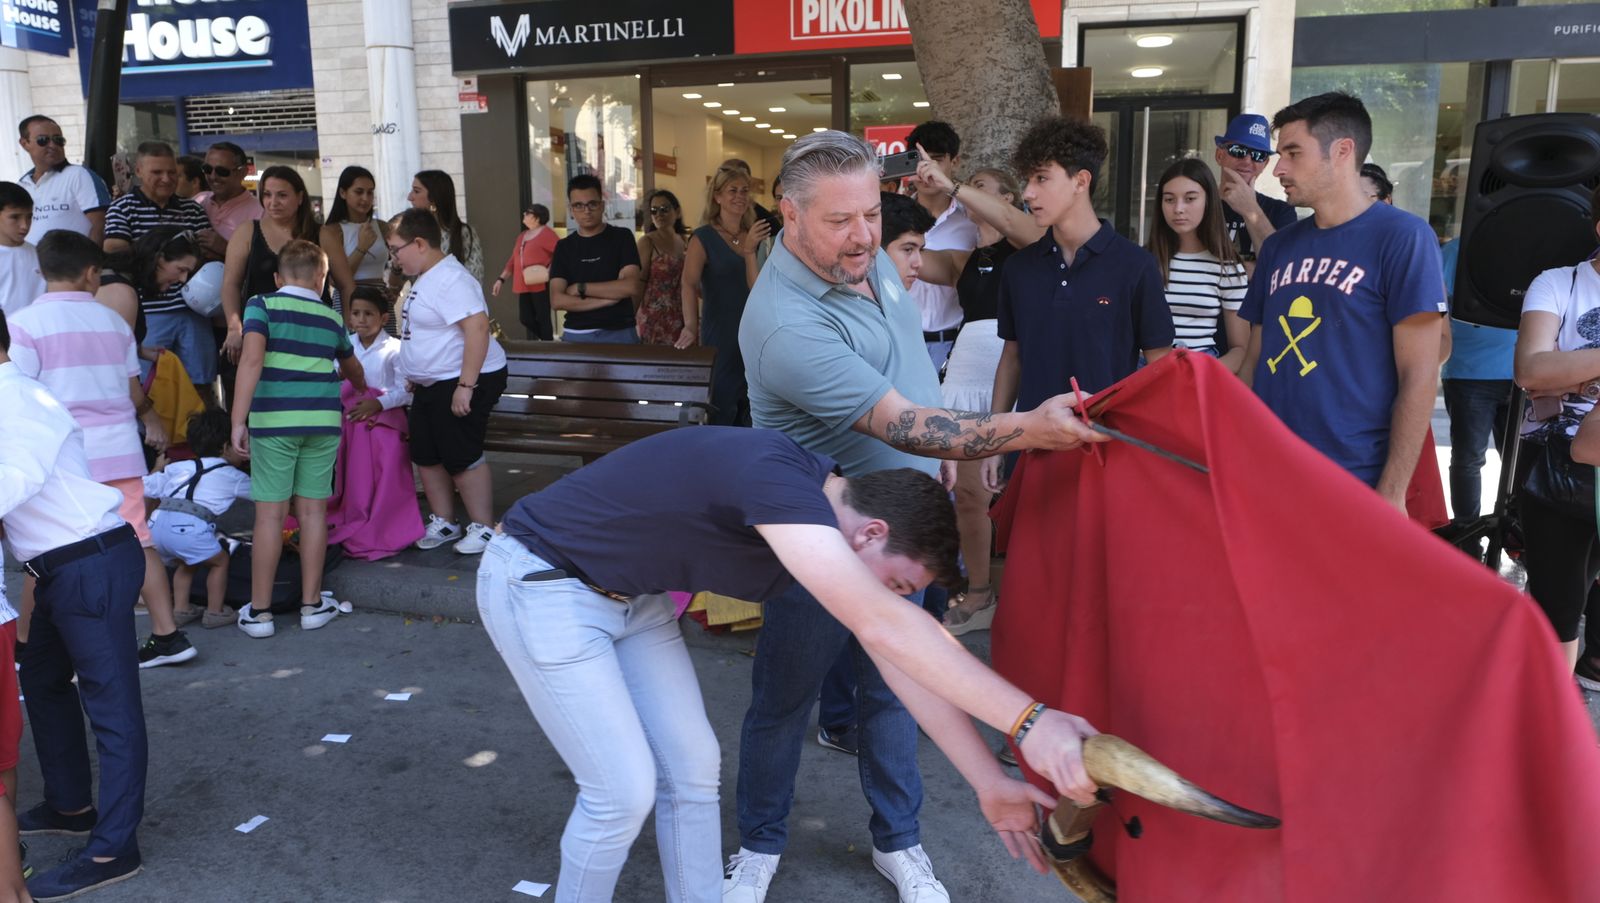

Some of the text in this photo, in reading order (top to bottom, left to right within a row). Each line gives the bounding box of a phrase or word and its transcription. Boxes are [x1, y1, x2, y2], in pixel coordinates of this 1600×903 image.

[3, 4, 61, 32] House
[534, 18, 685, 46] MARTINELLI
[1269, 257, 1366, 296] HARPER
